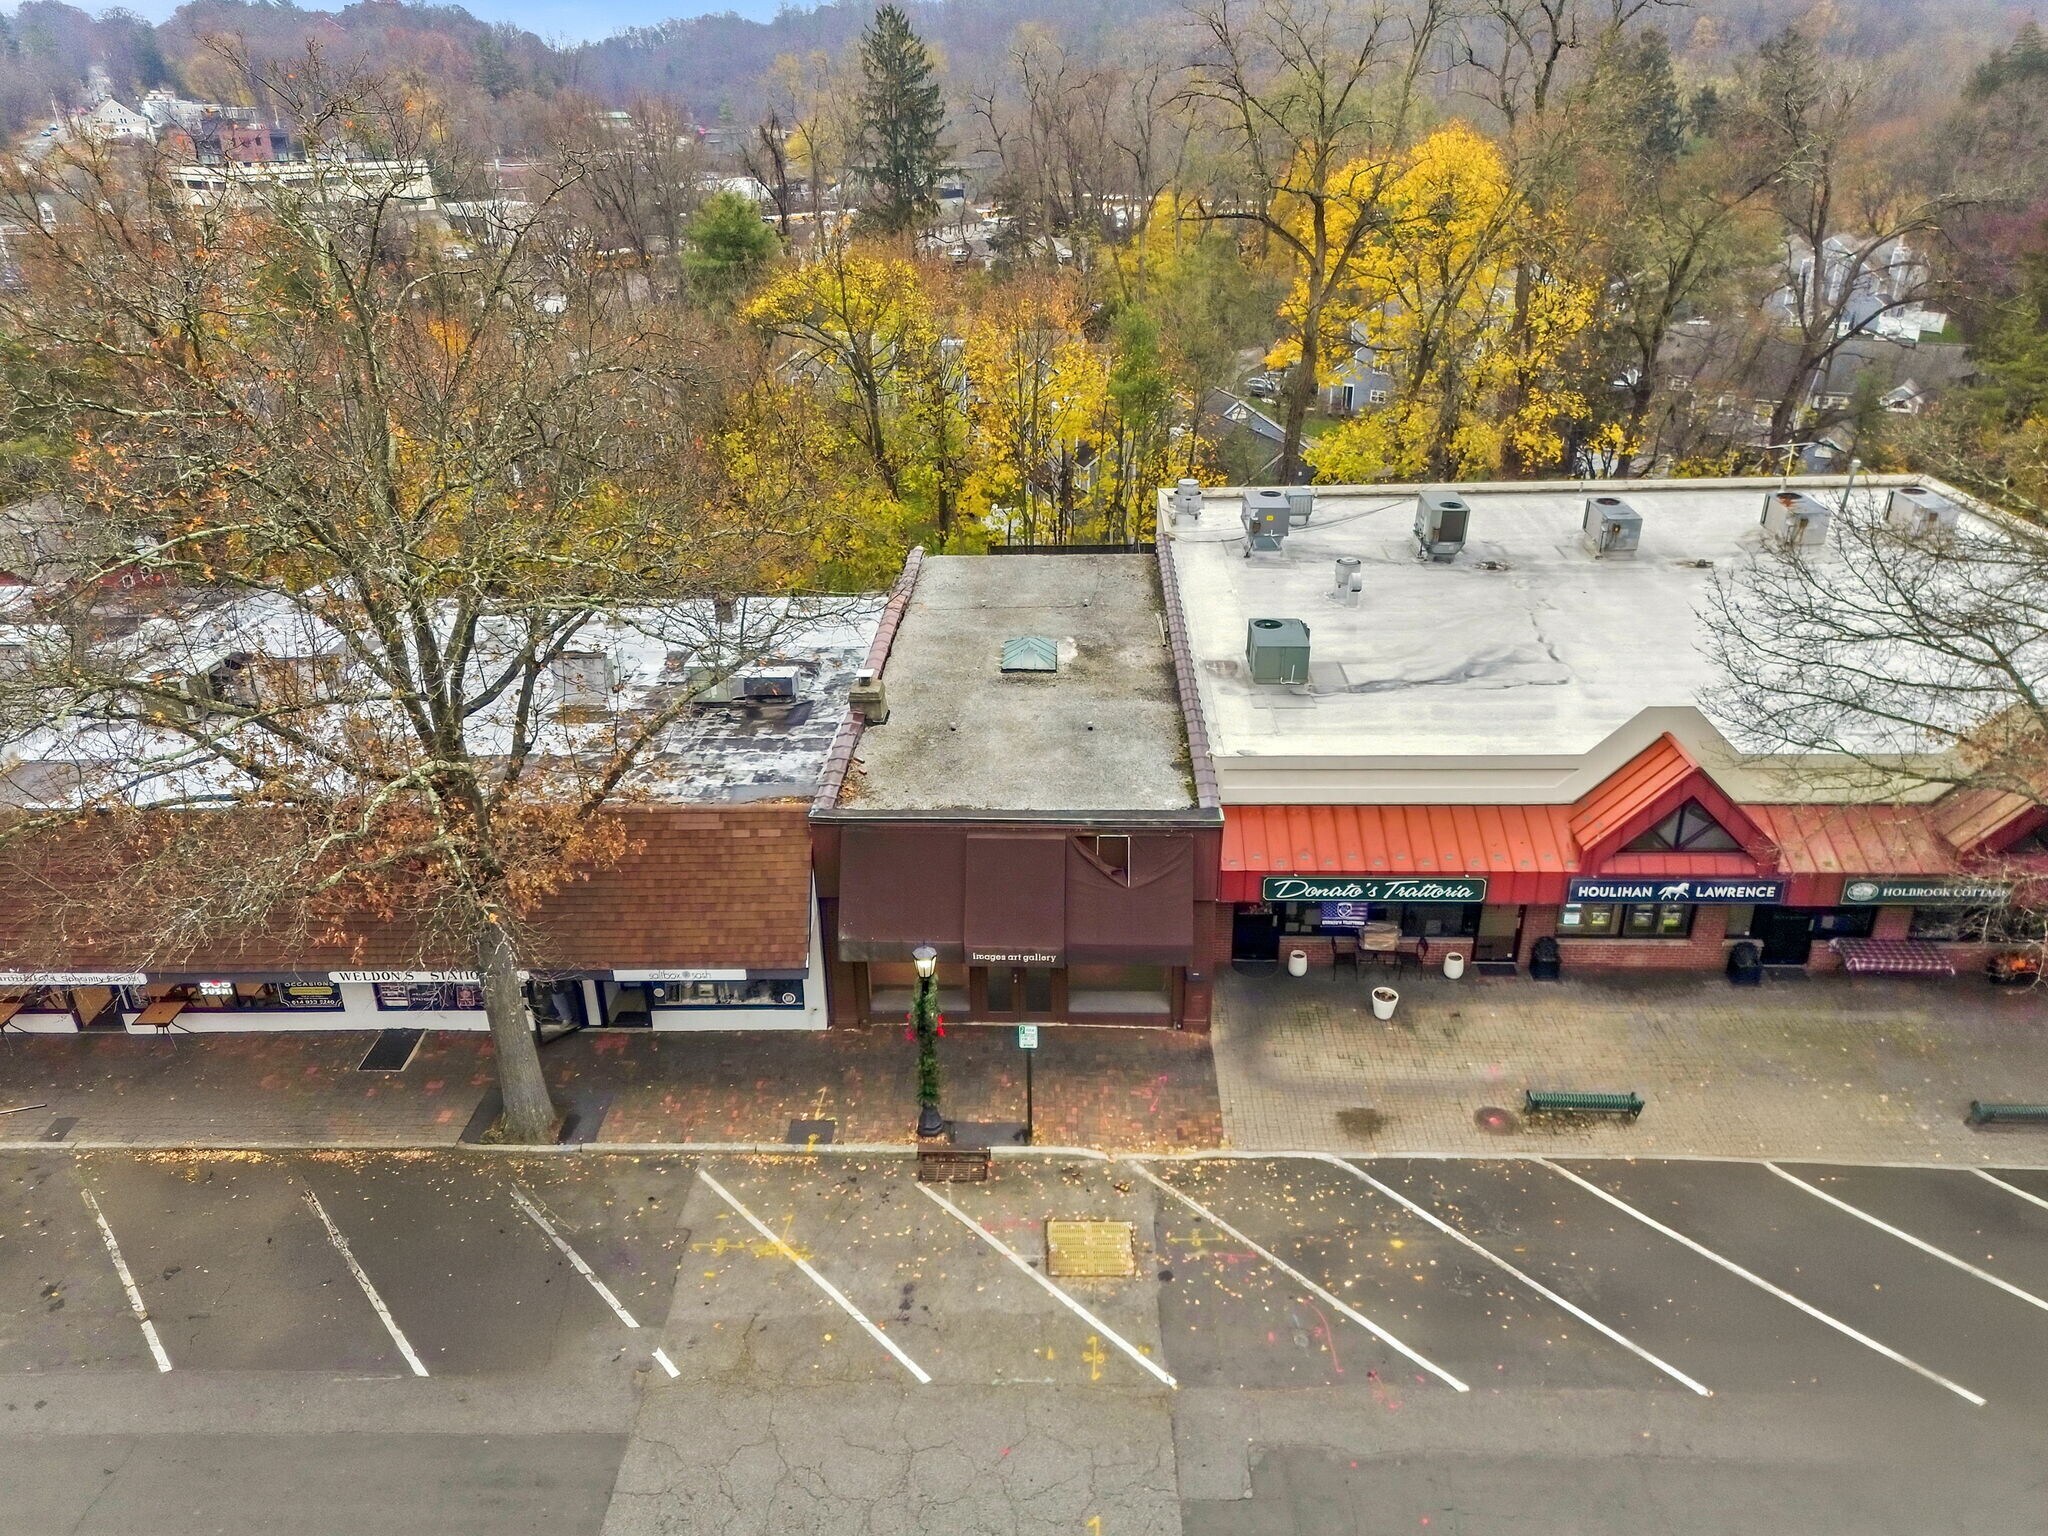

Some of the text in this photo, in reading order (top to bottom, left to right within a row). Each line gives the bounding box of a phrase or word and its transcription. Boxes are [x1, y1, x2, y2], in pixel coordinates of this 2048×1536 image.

[1274, 879, 1474, 899] Donato's Trattoria
[1578, 886, 1776, 898] HOULIHAN LAWRENCE
[1882, 887, 1950, 898] HOLBROOK
[972, 952, 1057, 963] images art gallery
[430, 970, 479, 982] STATIO
